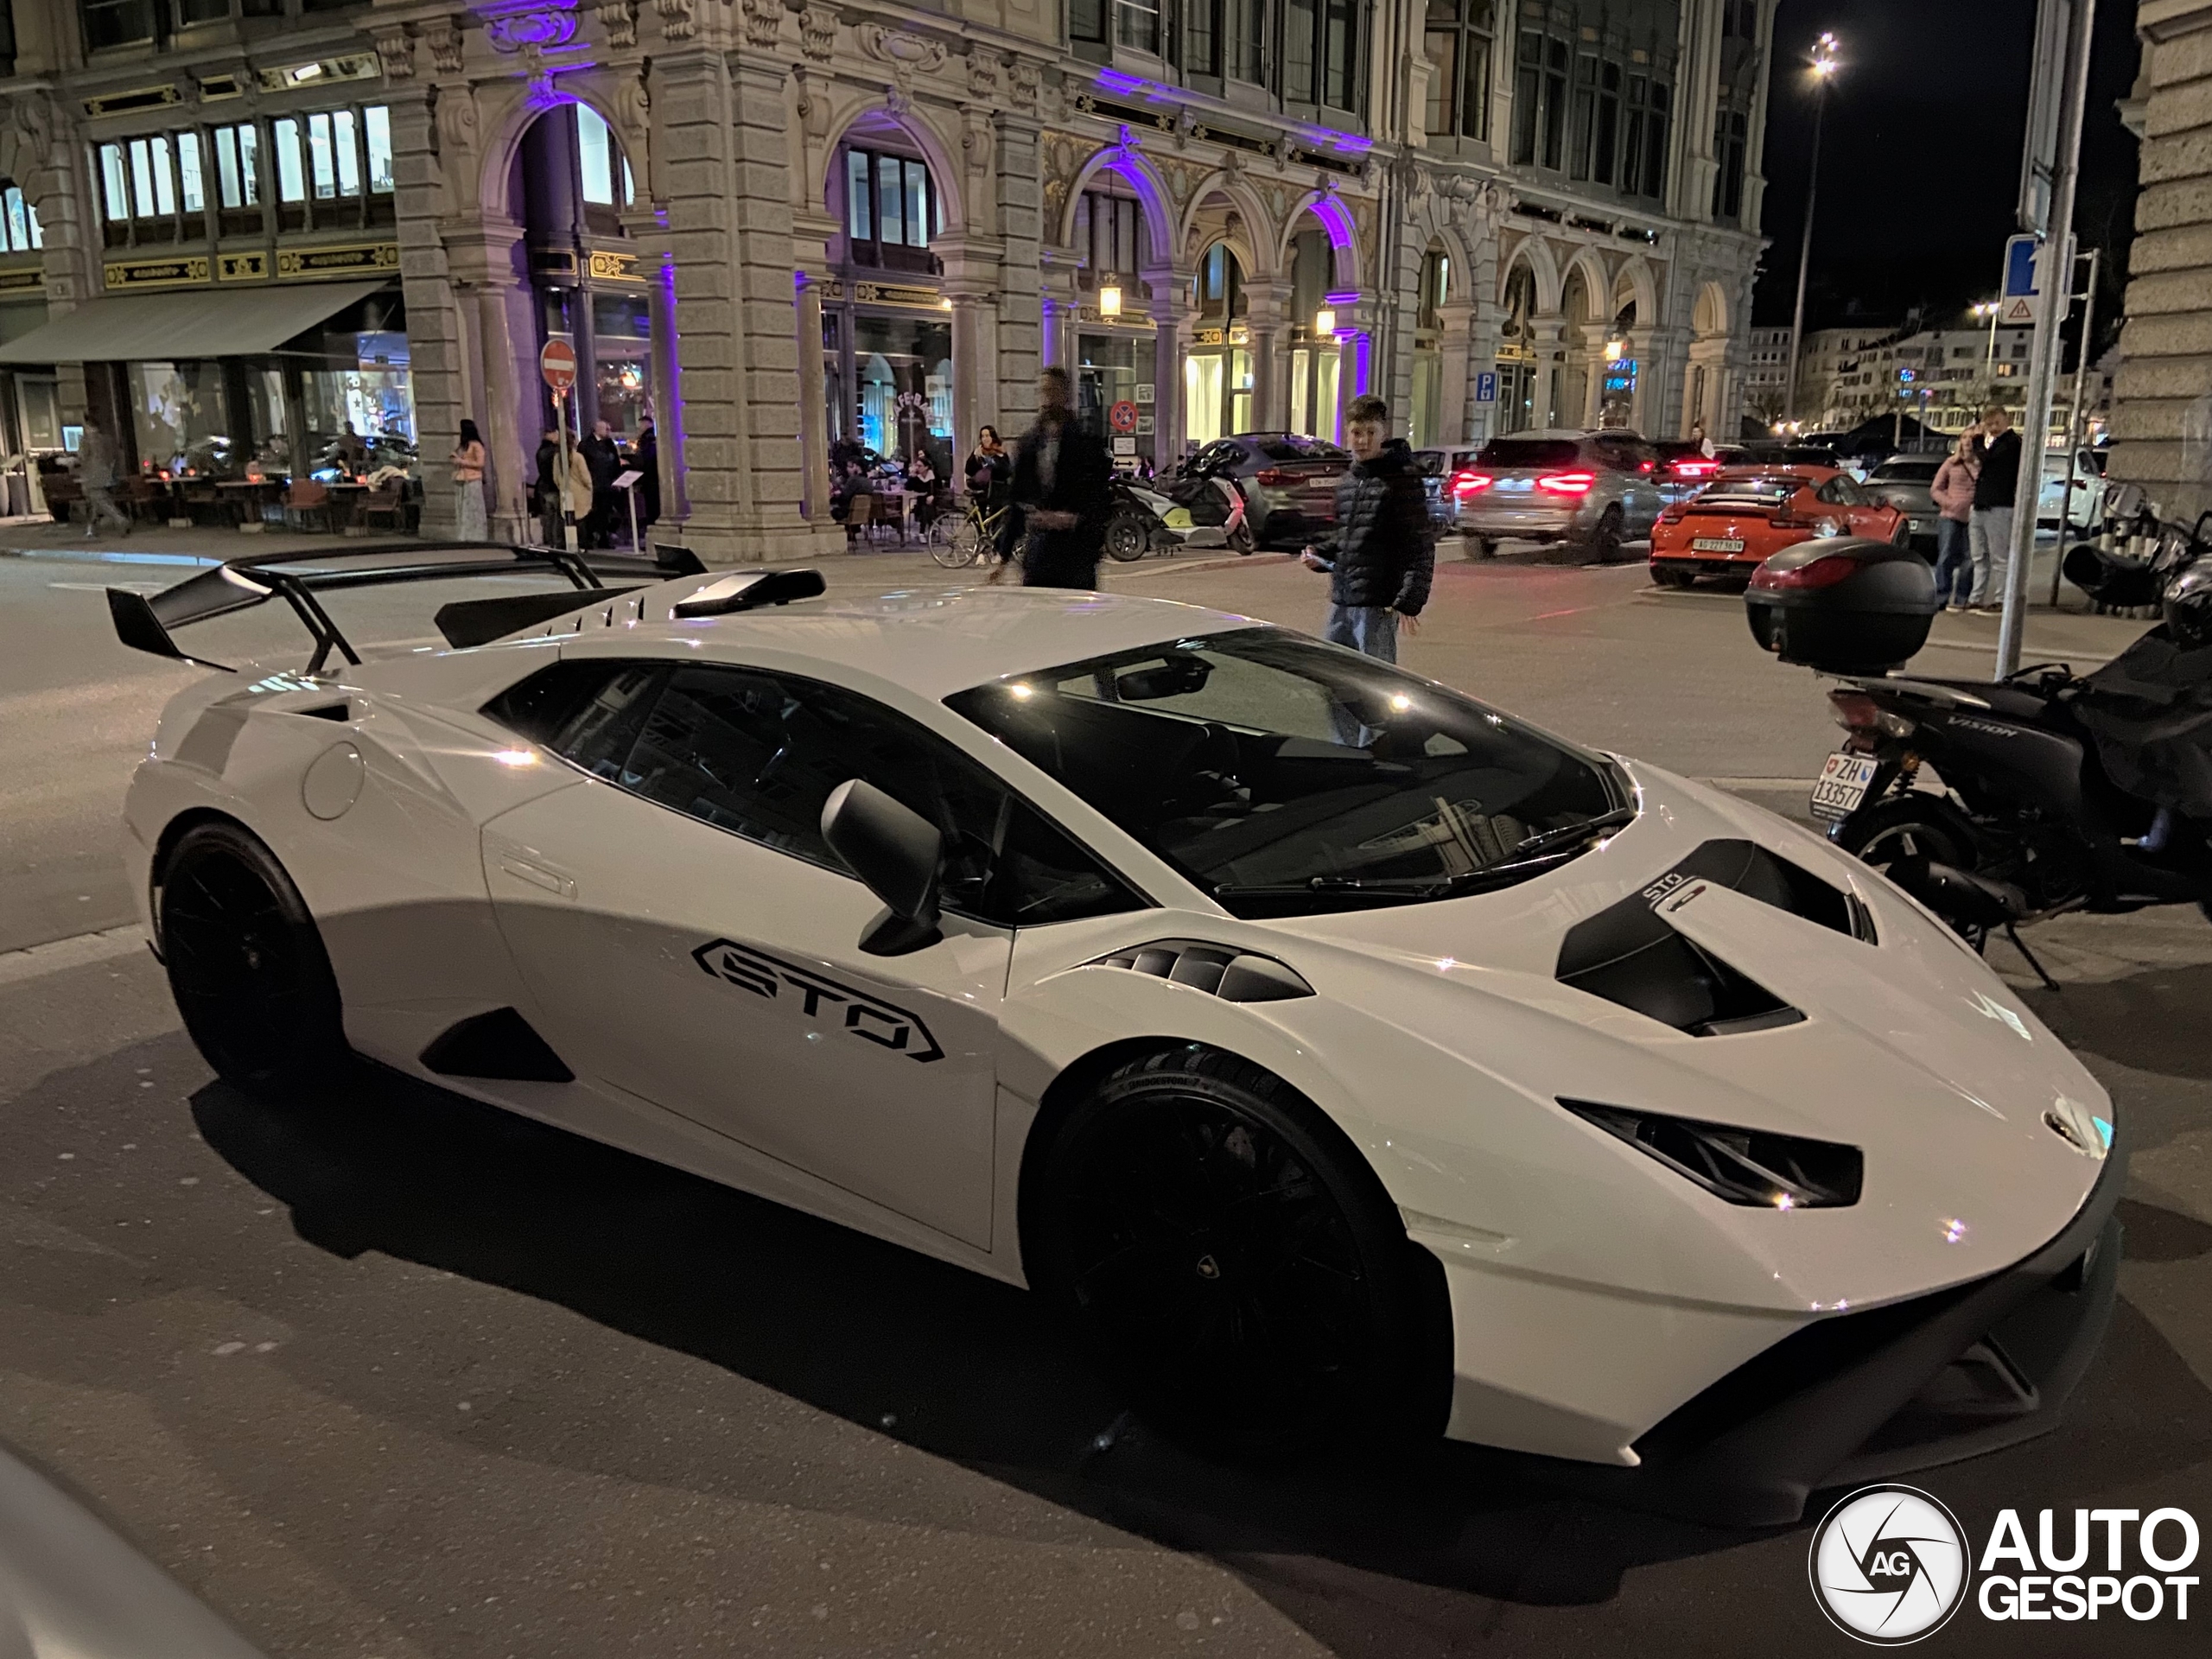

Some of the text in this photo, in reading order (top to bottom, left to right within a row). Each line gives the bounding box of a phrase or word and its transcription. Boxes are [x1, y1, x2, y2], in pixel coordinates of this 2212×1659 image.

[1482, 374, 1491, 389] P
[1699, 540, 1708, 549] AG
[1836, 759, 1862, 782] ZH
[1814, 780, 1864, 809] 133577
[1643, 873, 1683, 900] STO
[722, 951, 910, 1050] STO
